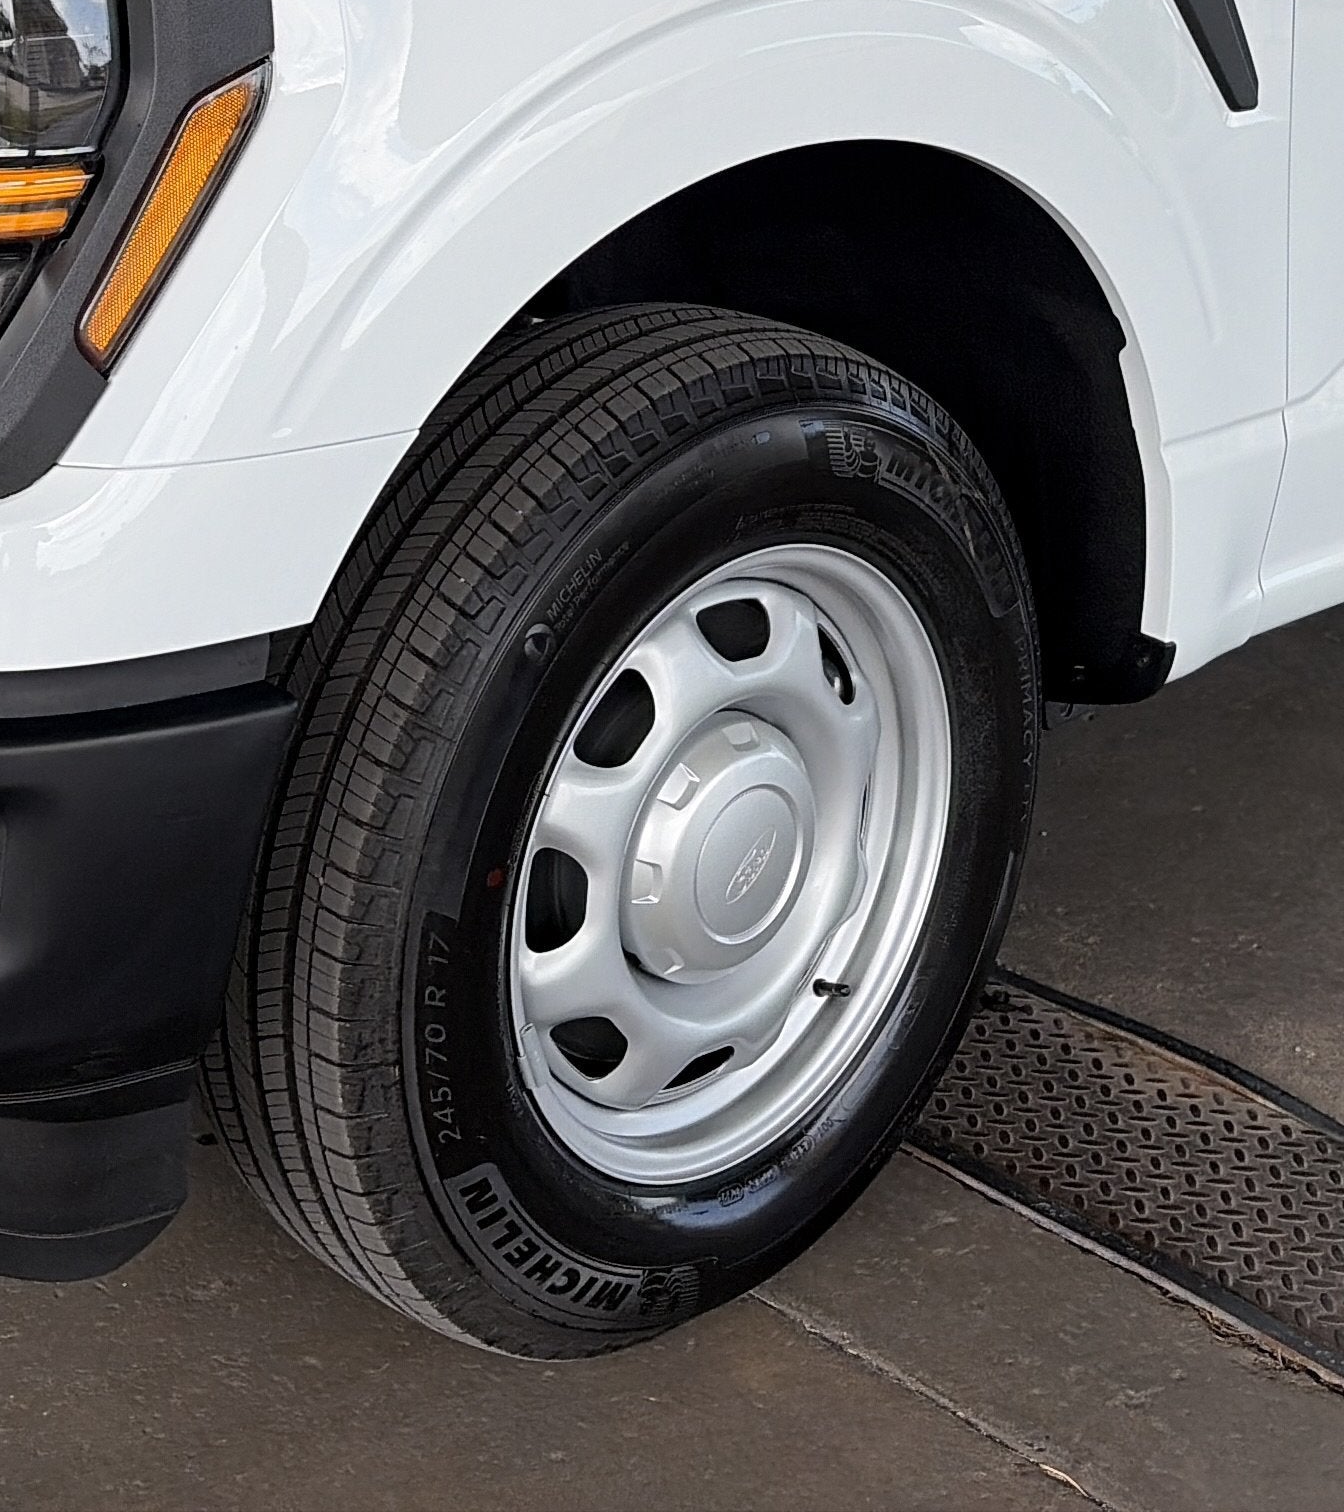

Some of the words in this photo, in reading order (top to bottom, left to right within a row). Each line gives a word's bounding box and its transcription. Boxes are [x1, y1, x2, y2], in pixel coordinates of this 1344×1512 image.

[546, 548, 603, 621] MICHELIN
[1014, 637, 1034, 767] PRIMACY
[424, 985, 448, 1008] R
[427, 931, 451, 965] 17
[424, 1023, 462, 1144] 245/70
[458, 1176, 634, 1312] MICHELIN
